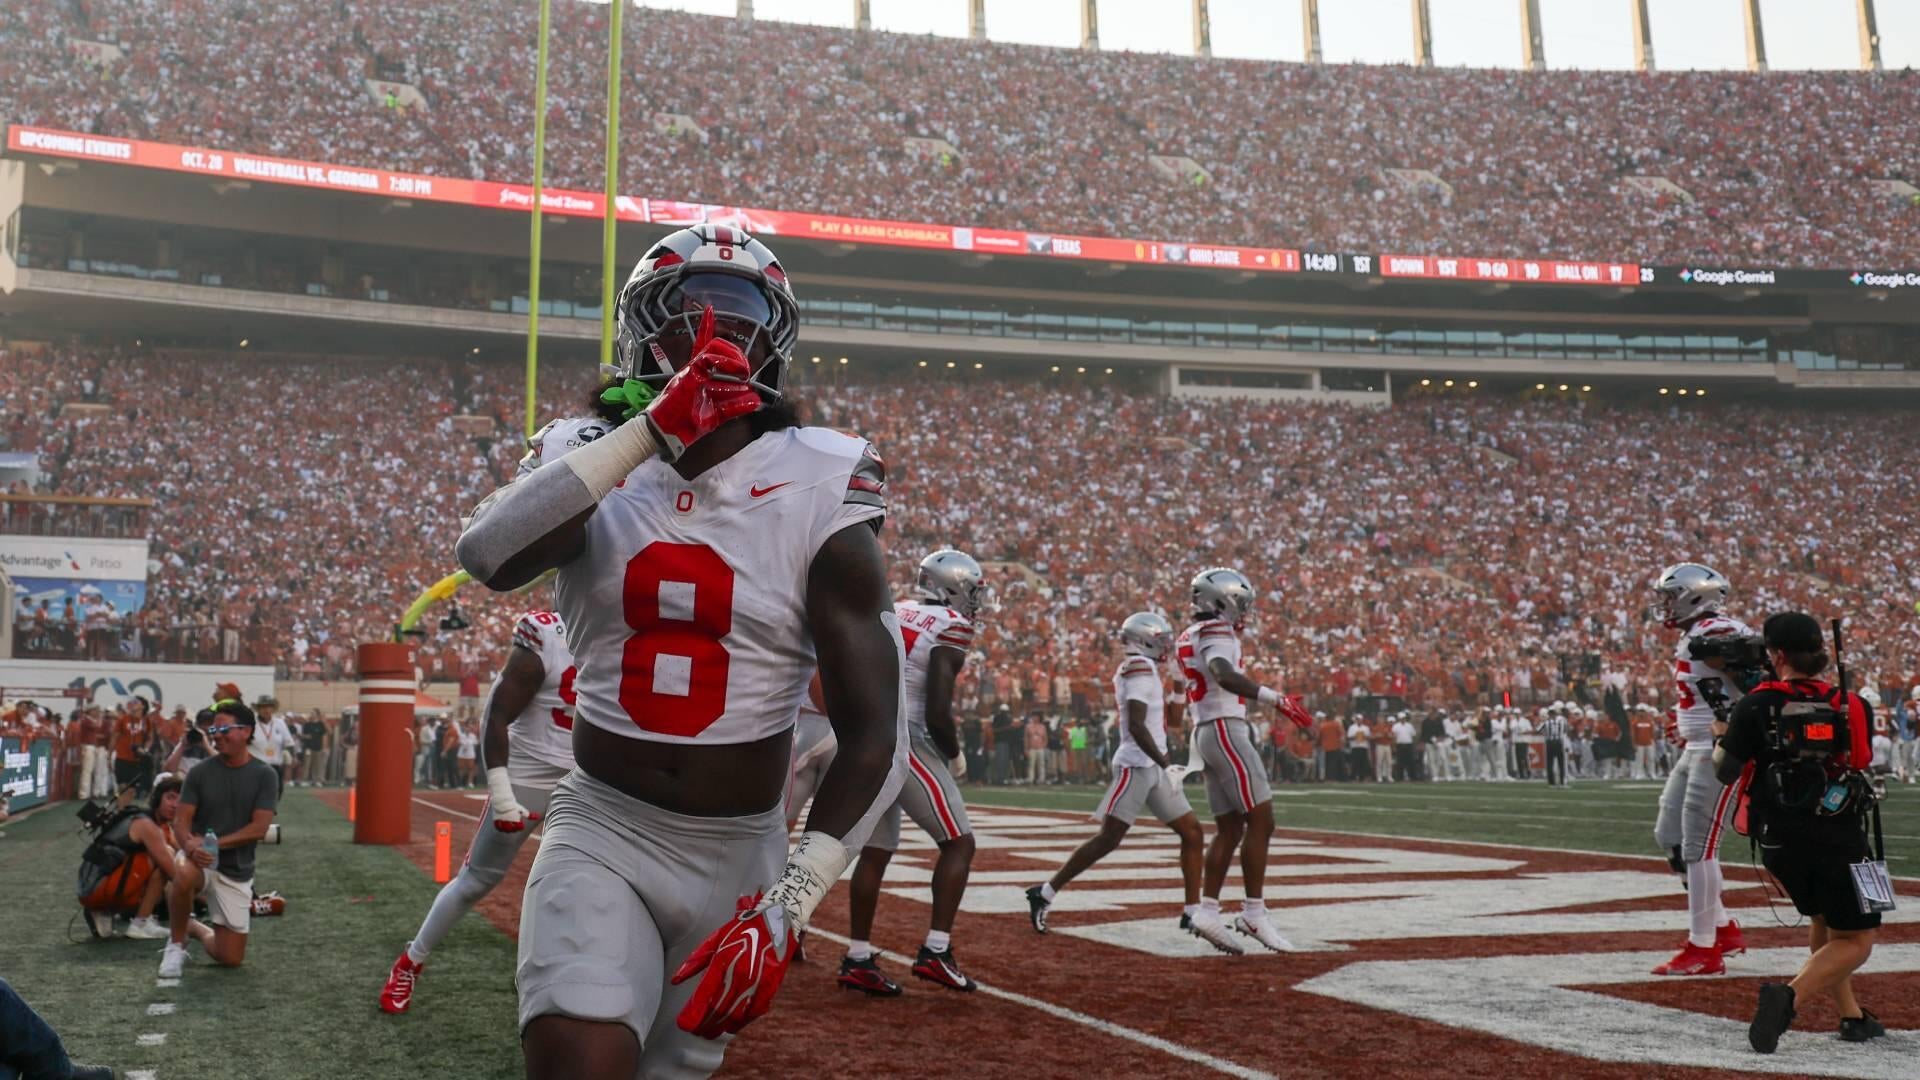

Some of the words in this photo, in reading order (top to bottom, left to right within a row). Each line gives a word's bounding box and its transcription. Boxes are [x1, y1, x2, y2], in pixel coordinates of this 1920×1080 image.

[19, 131, 84, 153] UPCOMING
[85, 139, 131, 158] EVENTS
[181, 151, 205, 168] OCT.
[234, 158, 306, 181] VOLLEYBALL
[307, 166, 327, 183] VS.
[328, 169, 379, 189] GEORGIA
[415, 179, 432, 194] PM
[811, 220, 840, 233] PLAY
[842, 223, 853, 234] &
[854, 224, 886, 237] EARN
[887, 226, 949, 242] CASHBACK
[1052, 238, 1081, 254] TEXAS
[1189, 248, 1213, 263] OHIO
[1214, 250, 1240, 265] STATE
[1353, 256, 1370, 273] 1ST
[1391, 258, 1424, 274] DOWN
[1437, 259, 1457, 275] 1ST
[1477, 261, 1491, 276] TO
[1492, 262, 1509, 277] GO
[1524, 263, 1540, 279] 10
[1556, 265, 1580, 280] BALL
[1581, 266, 1598, 280] ON
[1693, 270, 1734, 285] Google
[1735, 271, 1775, 283] Gemini
[1863, 273, 1905, 287] Google
[91, 556, 122, 569] Patio
[618, 540, 735, 737] 8
